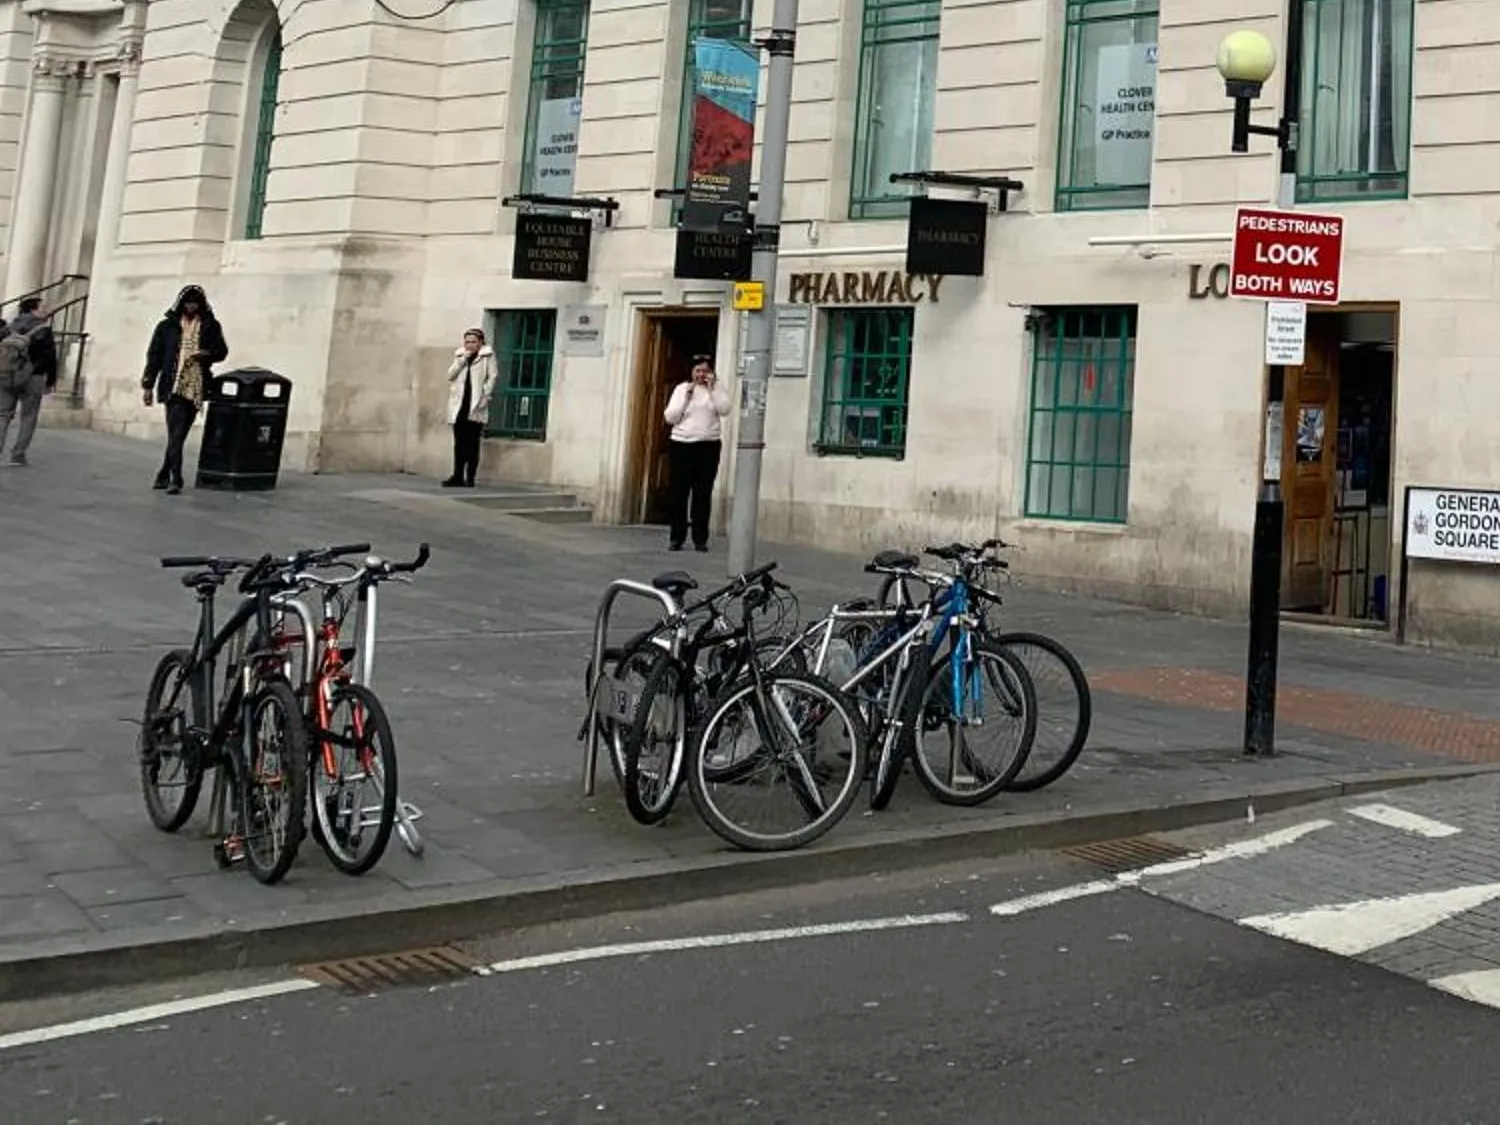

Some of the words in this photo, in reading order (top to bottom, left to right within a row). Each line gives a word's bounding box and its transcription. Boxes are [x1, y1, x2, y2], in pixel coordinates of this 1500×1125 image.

[1101, 102, 1135, 113] HEALTH
[1138, 101, 1155, 112] CEN
[1101, 130, 1114, 140] GP
[525, 222, 586, 236] EQUITABLE
[1239, 216, 1340, 236] PEDESTRIANS
[537, 236, 572, 248] HOUSE
[694, 233, 740, 245] HEALTH
[916, 230, 979, 244] PHARMACY
[527, 248, 580, 261] BUSINESS
[693, 246, 737, 258] CENTRE
[1255, 242, 1320, 266] LOOK
[530, 261, 573, 274] CENTRE
[788, 271, 944, 303] PHARMACY
[1235, 275, 1282, 292] BOTH
[1289, 277, 1335, 295] WAYS
[1434, 530, 1499, 550] SQUARE
